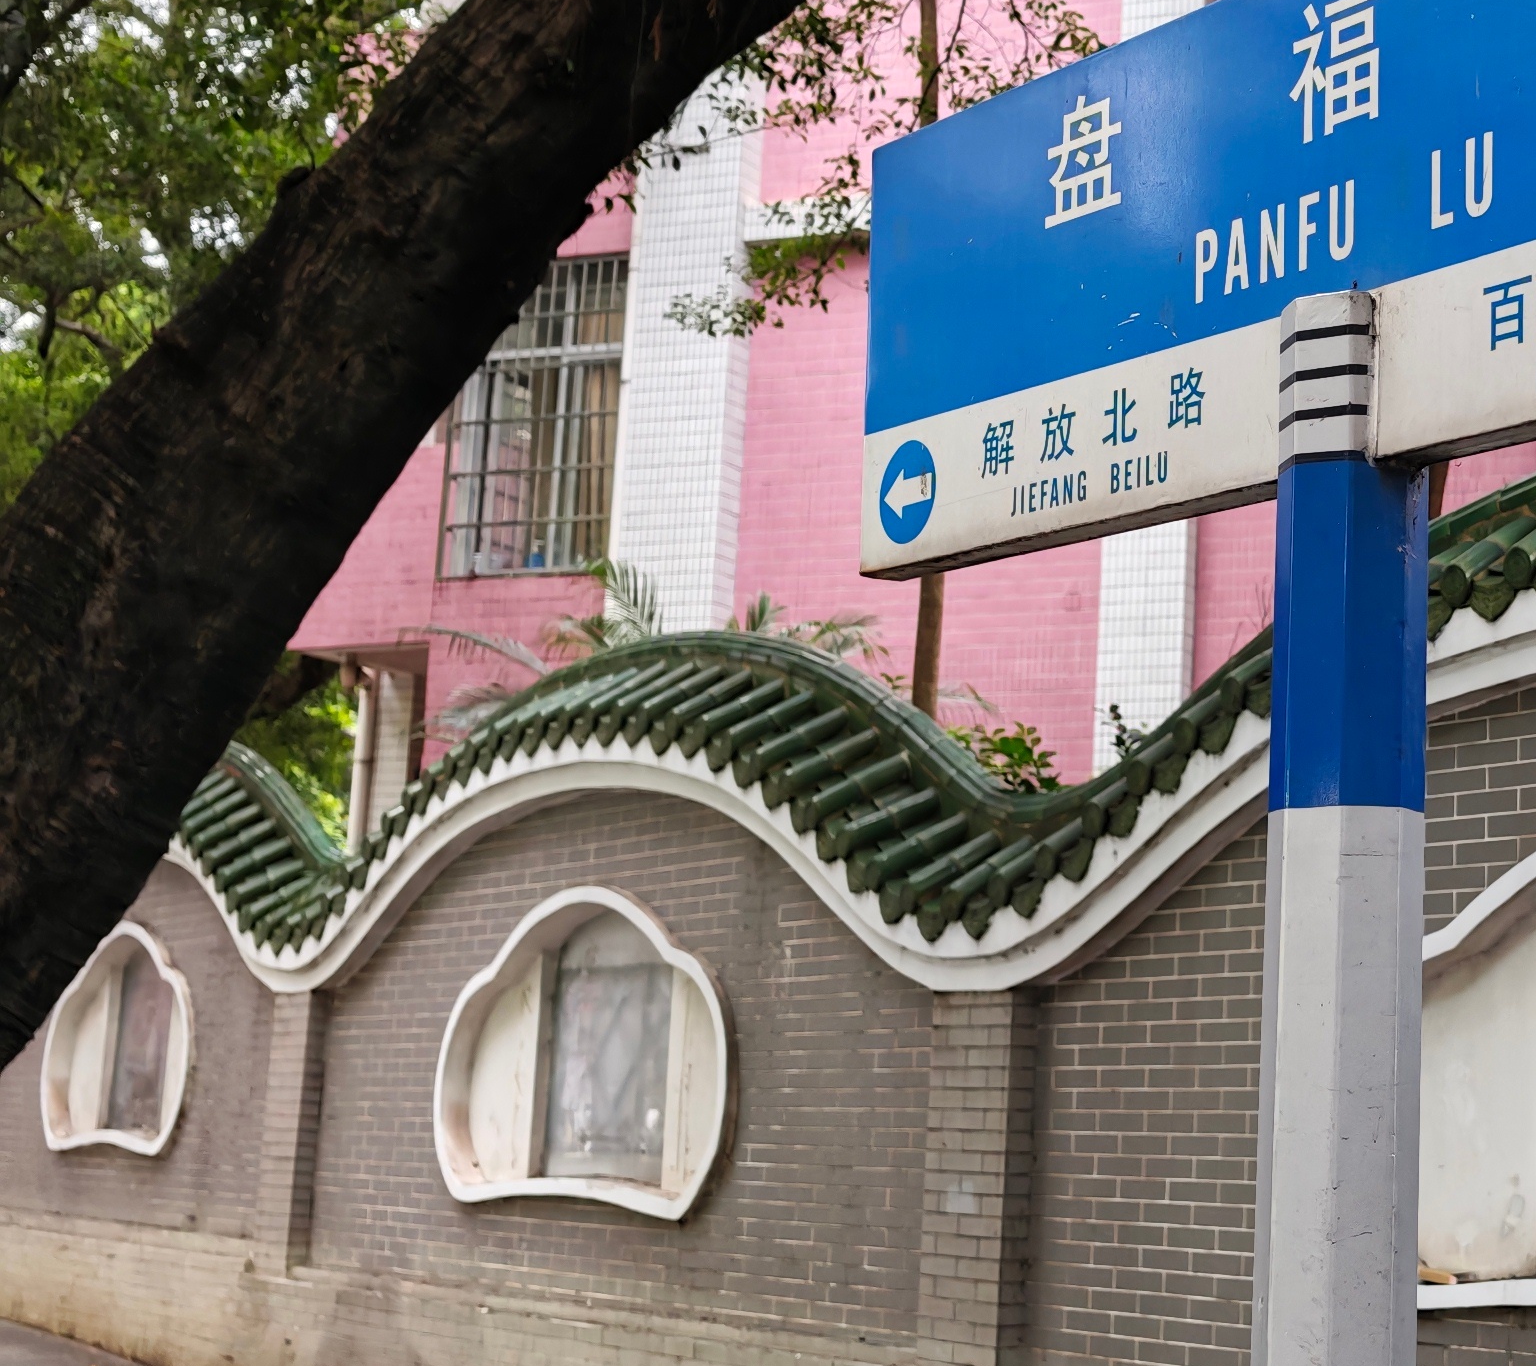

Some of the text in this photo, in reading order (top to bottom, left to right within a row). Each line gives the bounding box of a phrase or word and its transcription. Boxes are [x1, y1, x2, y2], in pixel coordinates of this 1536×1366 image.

[1195, 131, 1494, 304] PANFU LU
[981, 367, 1206, 479] 解放北路
[1011, 450, 1169, 517] JIEFANG BEILU
